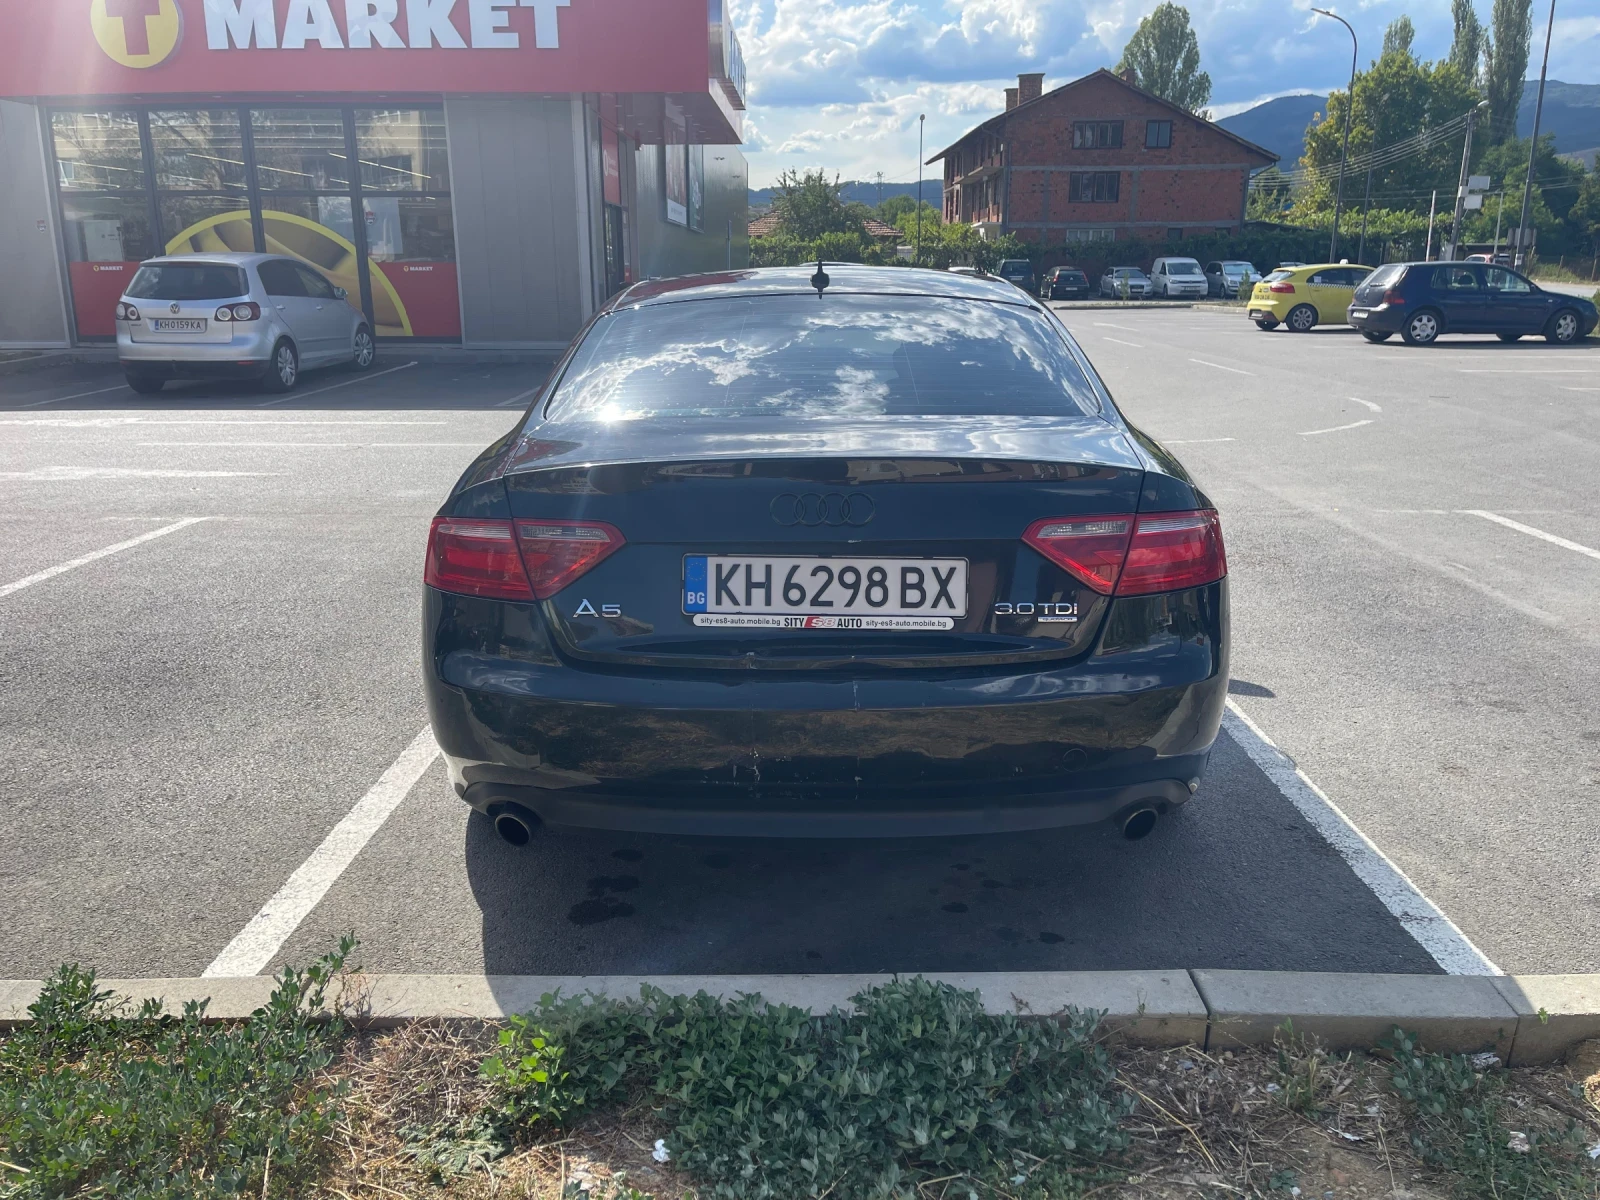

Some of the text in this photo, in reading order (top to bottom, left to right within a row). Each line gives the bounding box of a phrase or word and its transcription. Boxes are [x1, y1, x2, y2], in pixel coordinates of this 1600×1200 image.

[202, 0, 571, 50] MARKET
[687, 592, 705, 604] BG
[572, 598, 622, 618] A5
[994, 602, 1078, 615] 3.0 TDI
[784, 617, 805, 628] SITY
[836, 618, 862, 628] AUTO
